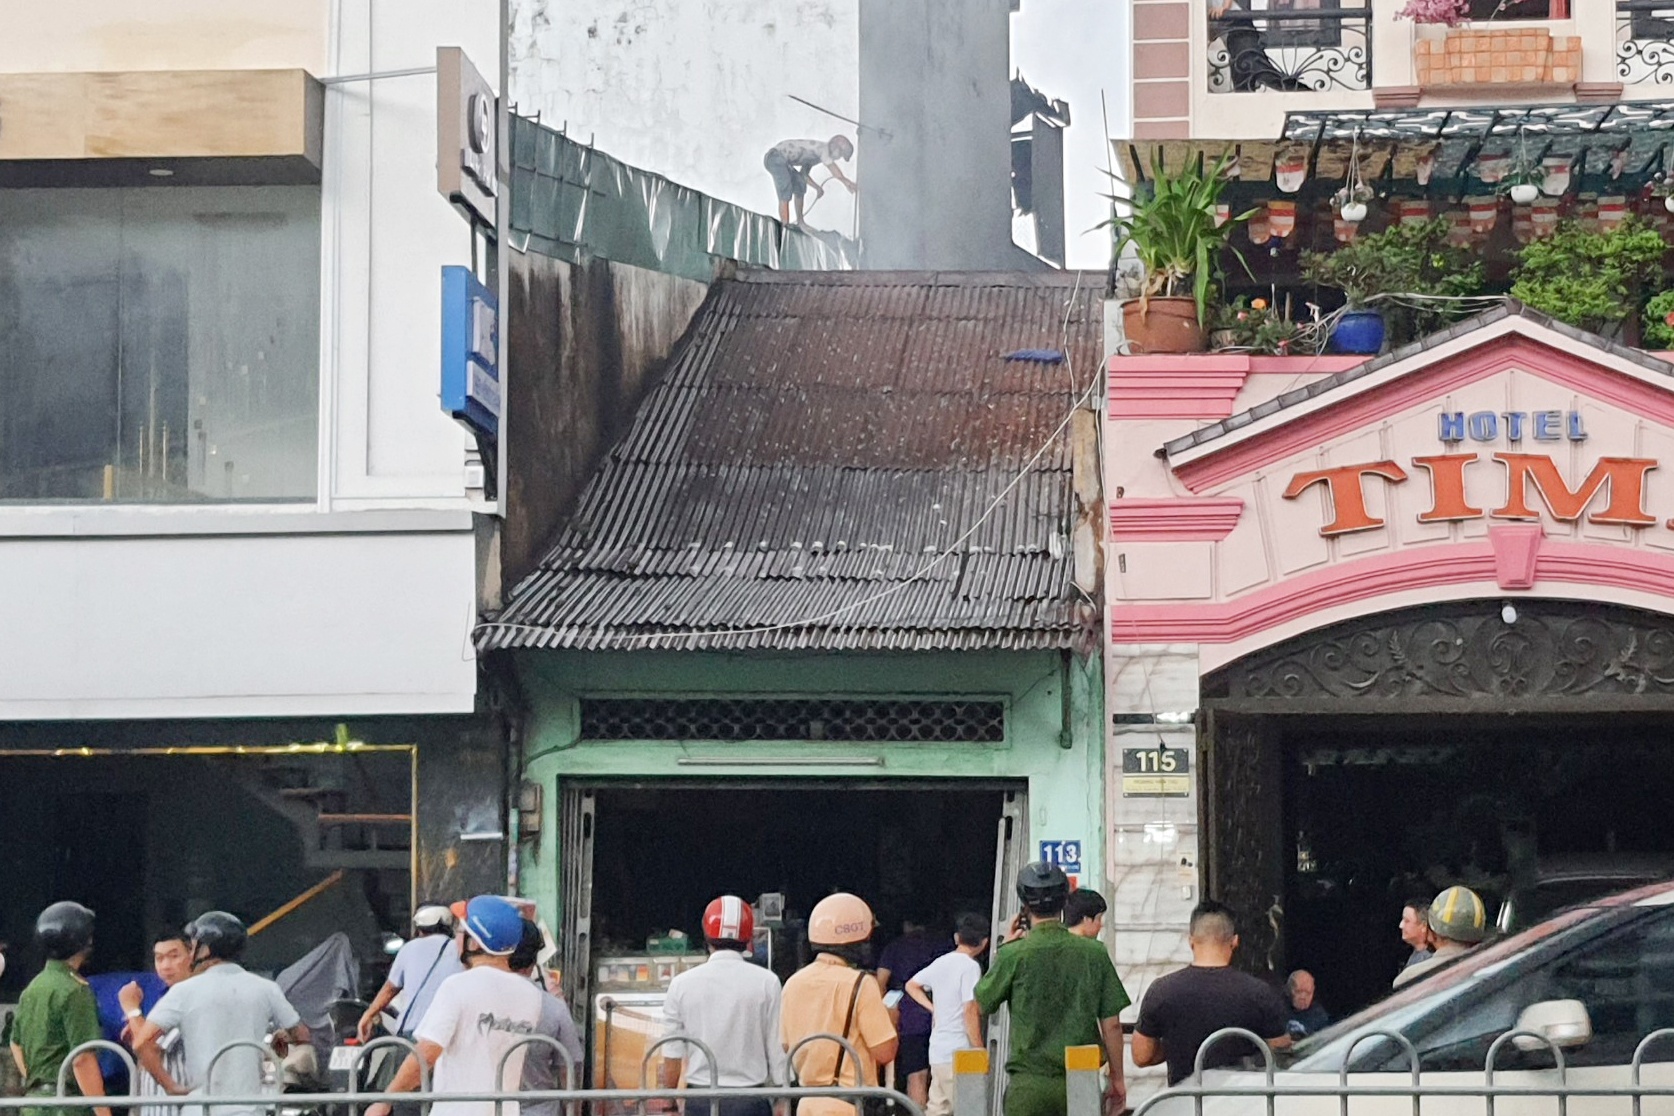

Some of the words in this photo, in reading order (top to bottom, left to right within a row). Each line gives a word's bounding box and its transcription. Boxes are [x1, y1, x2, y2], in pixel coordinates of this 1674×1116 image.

[1438, 410, 1588, 442] HOTEL
[1282, 452, 1674, 536] TIM
[1136, 750, 1177, 772] 115
[1043, 844, 1078, 863] 113
